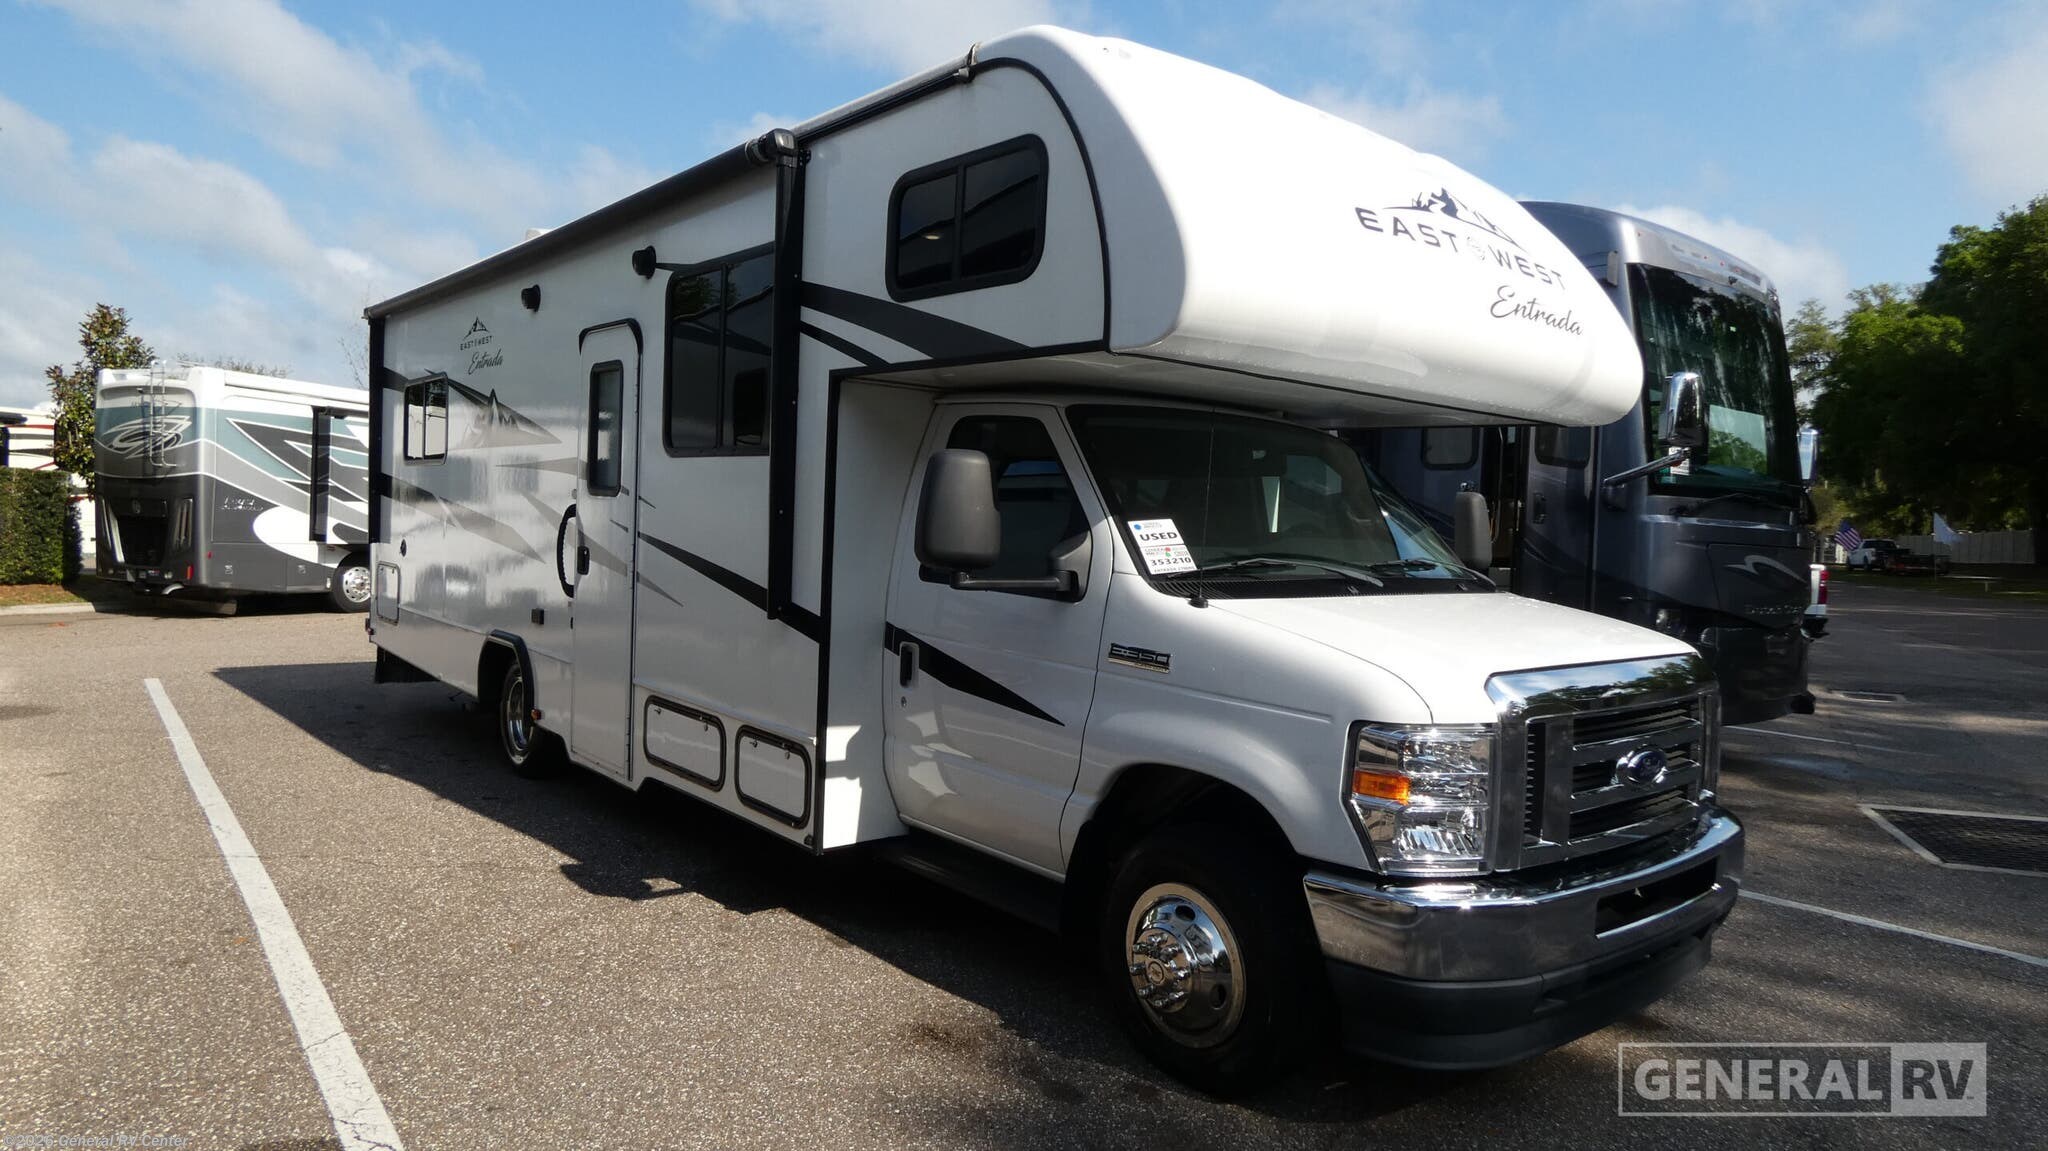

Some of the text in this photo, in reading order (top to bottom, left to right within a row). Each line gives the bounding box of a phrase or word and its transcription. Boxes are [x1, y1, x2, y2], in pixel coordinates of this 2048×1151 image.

[1354, 206, 1566, 290] EAST WEST
[1489, 284, 1584, 336] Entrada
[467, 348, 504, 375] Entrada
[1140, 532, 1178, 541] USED
[1151, 556, 1192, 567] 353210
